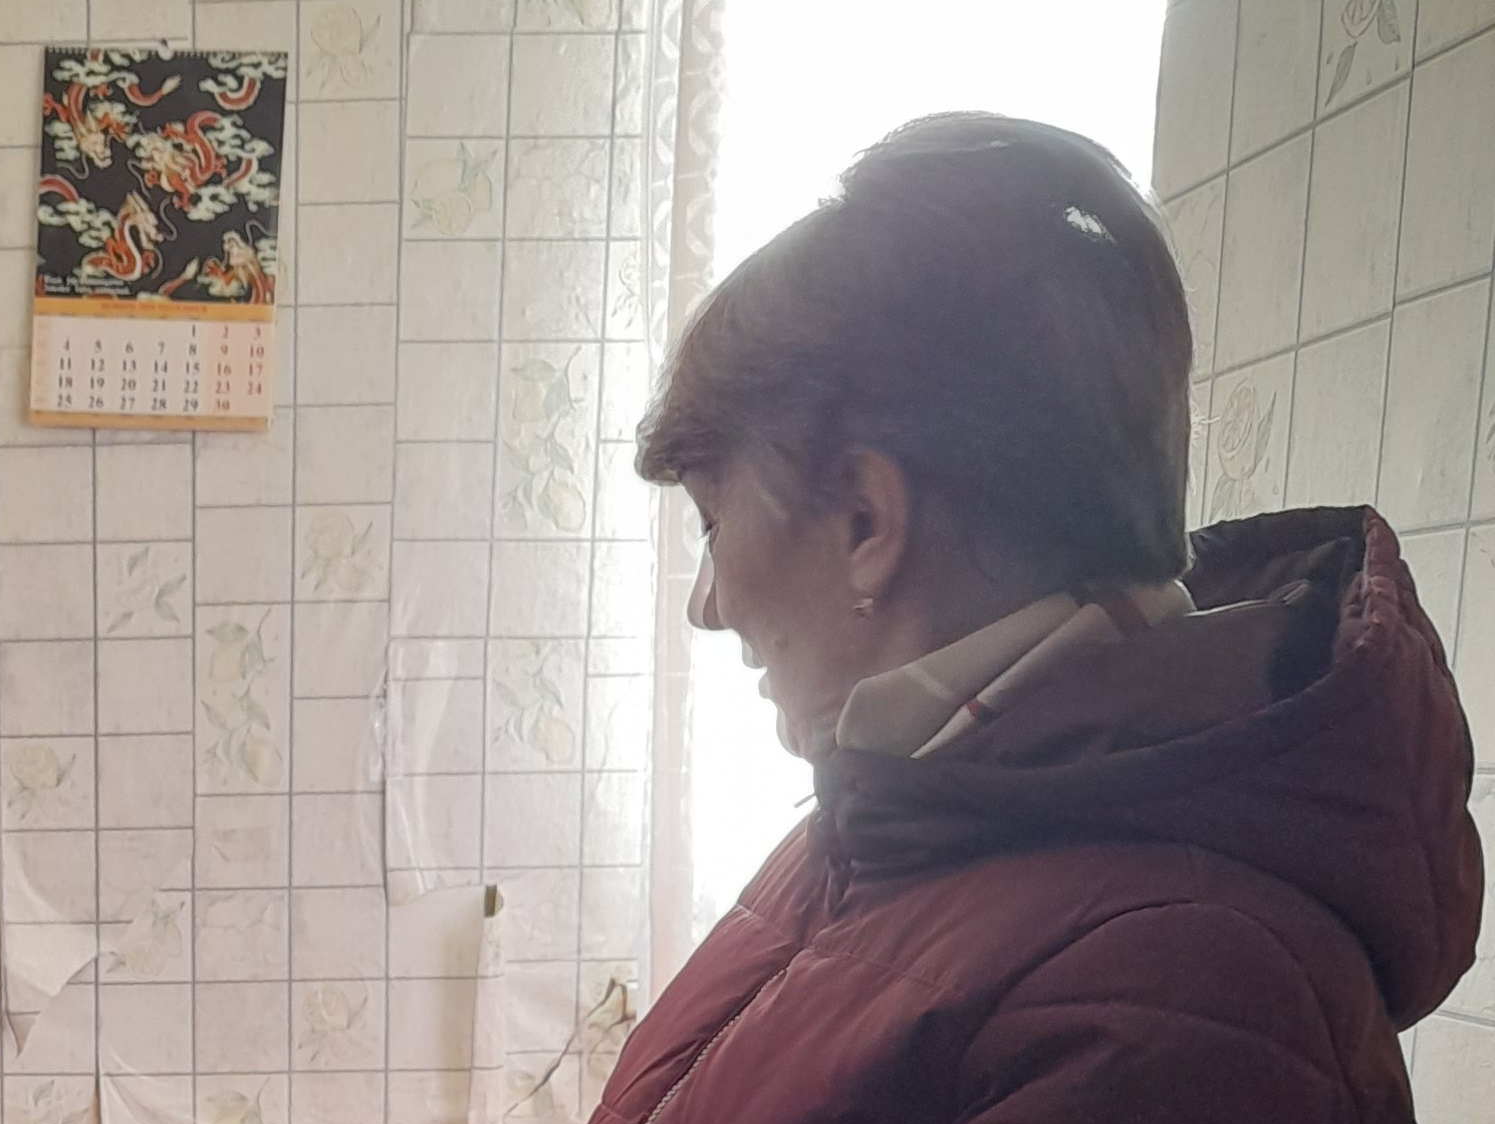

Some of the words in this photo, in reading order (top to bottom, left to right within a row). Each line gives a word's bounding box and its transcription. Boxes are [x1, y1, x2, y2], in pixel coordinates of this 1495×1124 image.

[192, 325, 196, 337] 1
[223, 326, 229, 338] 2
[126, 342, 133, 352] 6
[158, 343, 165, 353] 7
[189, 344, 196, 355] 8
[221, 344, 227, 355] 9
[250, 346, 264, 357] 10
[60, 359, 71, 370] 11
[91, 359, 104, 371] 12
[122, 360, 136, 371] 13
[154, 361, 167, 373] 14
[186, 361, 199, 373] 15
[217, 362, 231, 374] 16
[249, 364, 262, 376] 17
[58, 377, 72, 388] 18
[90, 377, 104, 389] 19
[121, 379, 136, 391] 20
[152, 379, 166, 391] 21
[184, 381, 198, 392] 22
[216, 381, 230, 393] 23
[88, 396, 104, 408] 26
[120, 397, 135, 409] 27
[183, 398, 199, 411] 29
